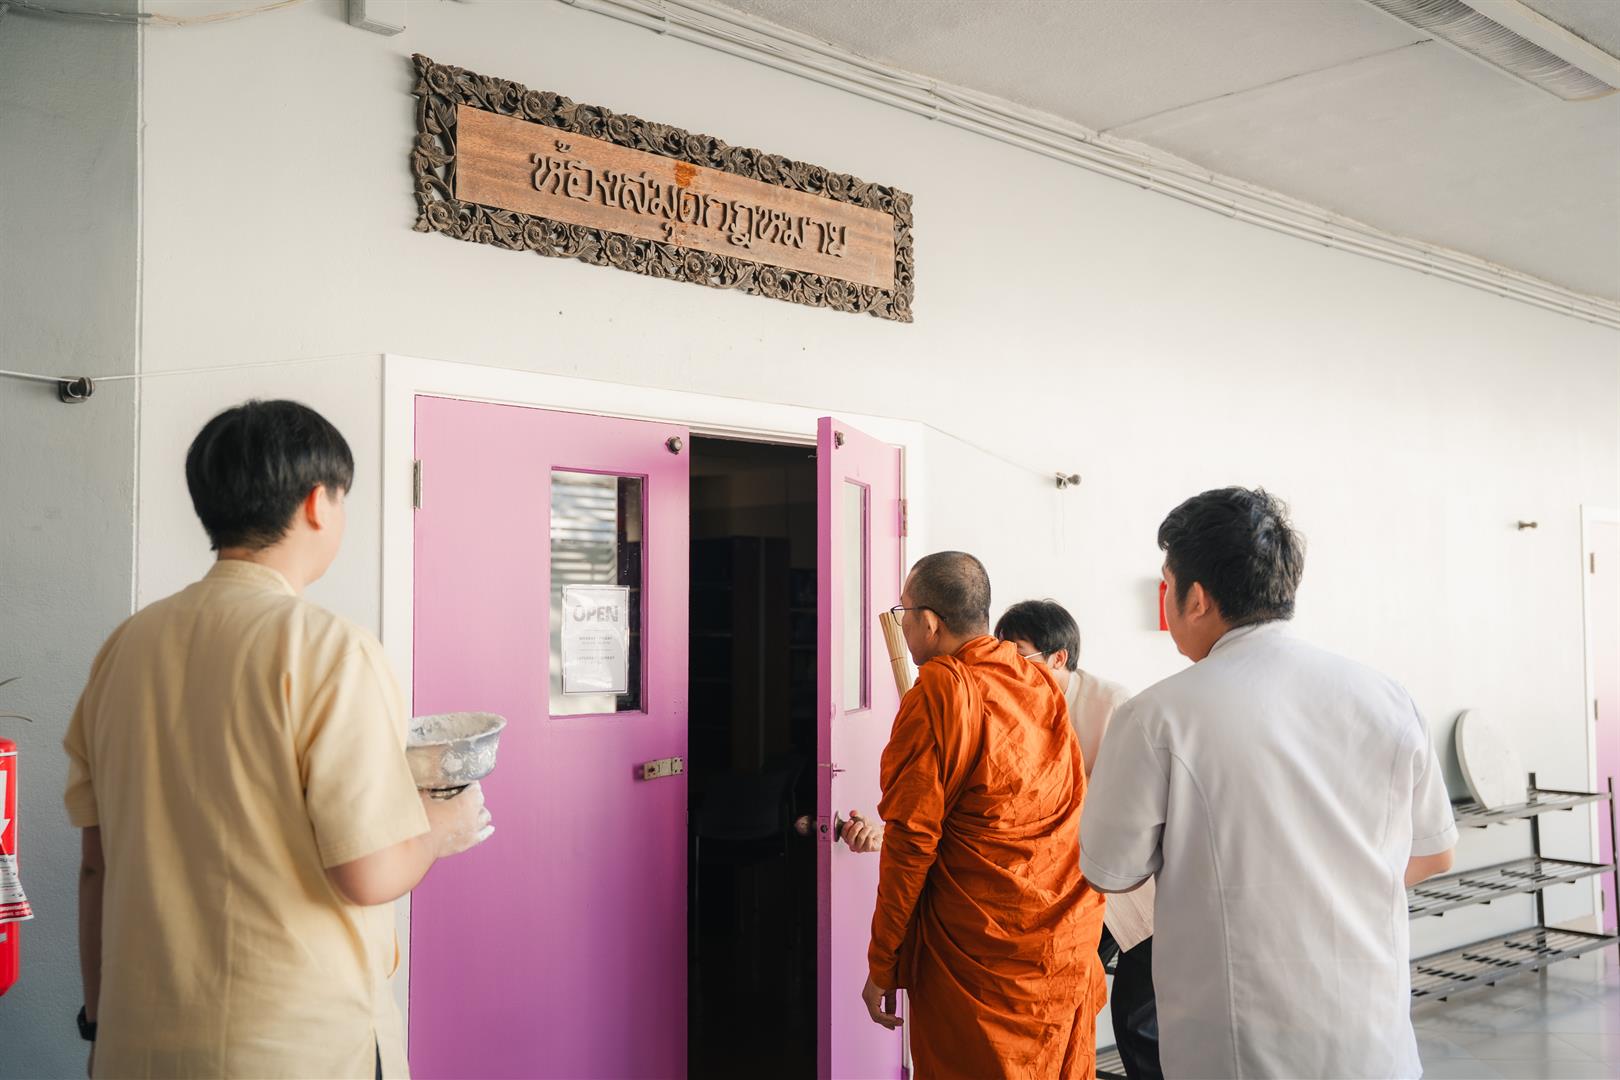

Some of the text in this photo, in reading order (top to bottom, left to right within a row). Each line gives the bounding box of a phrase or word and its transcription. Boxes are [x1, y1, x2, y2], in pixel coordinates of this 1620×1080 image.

[532, 139, 847, 257] ห้องสมุดกฎหมาย
[573, 605, 618, 622] OPEN
